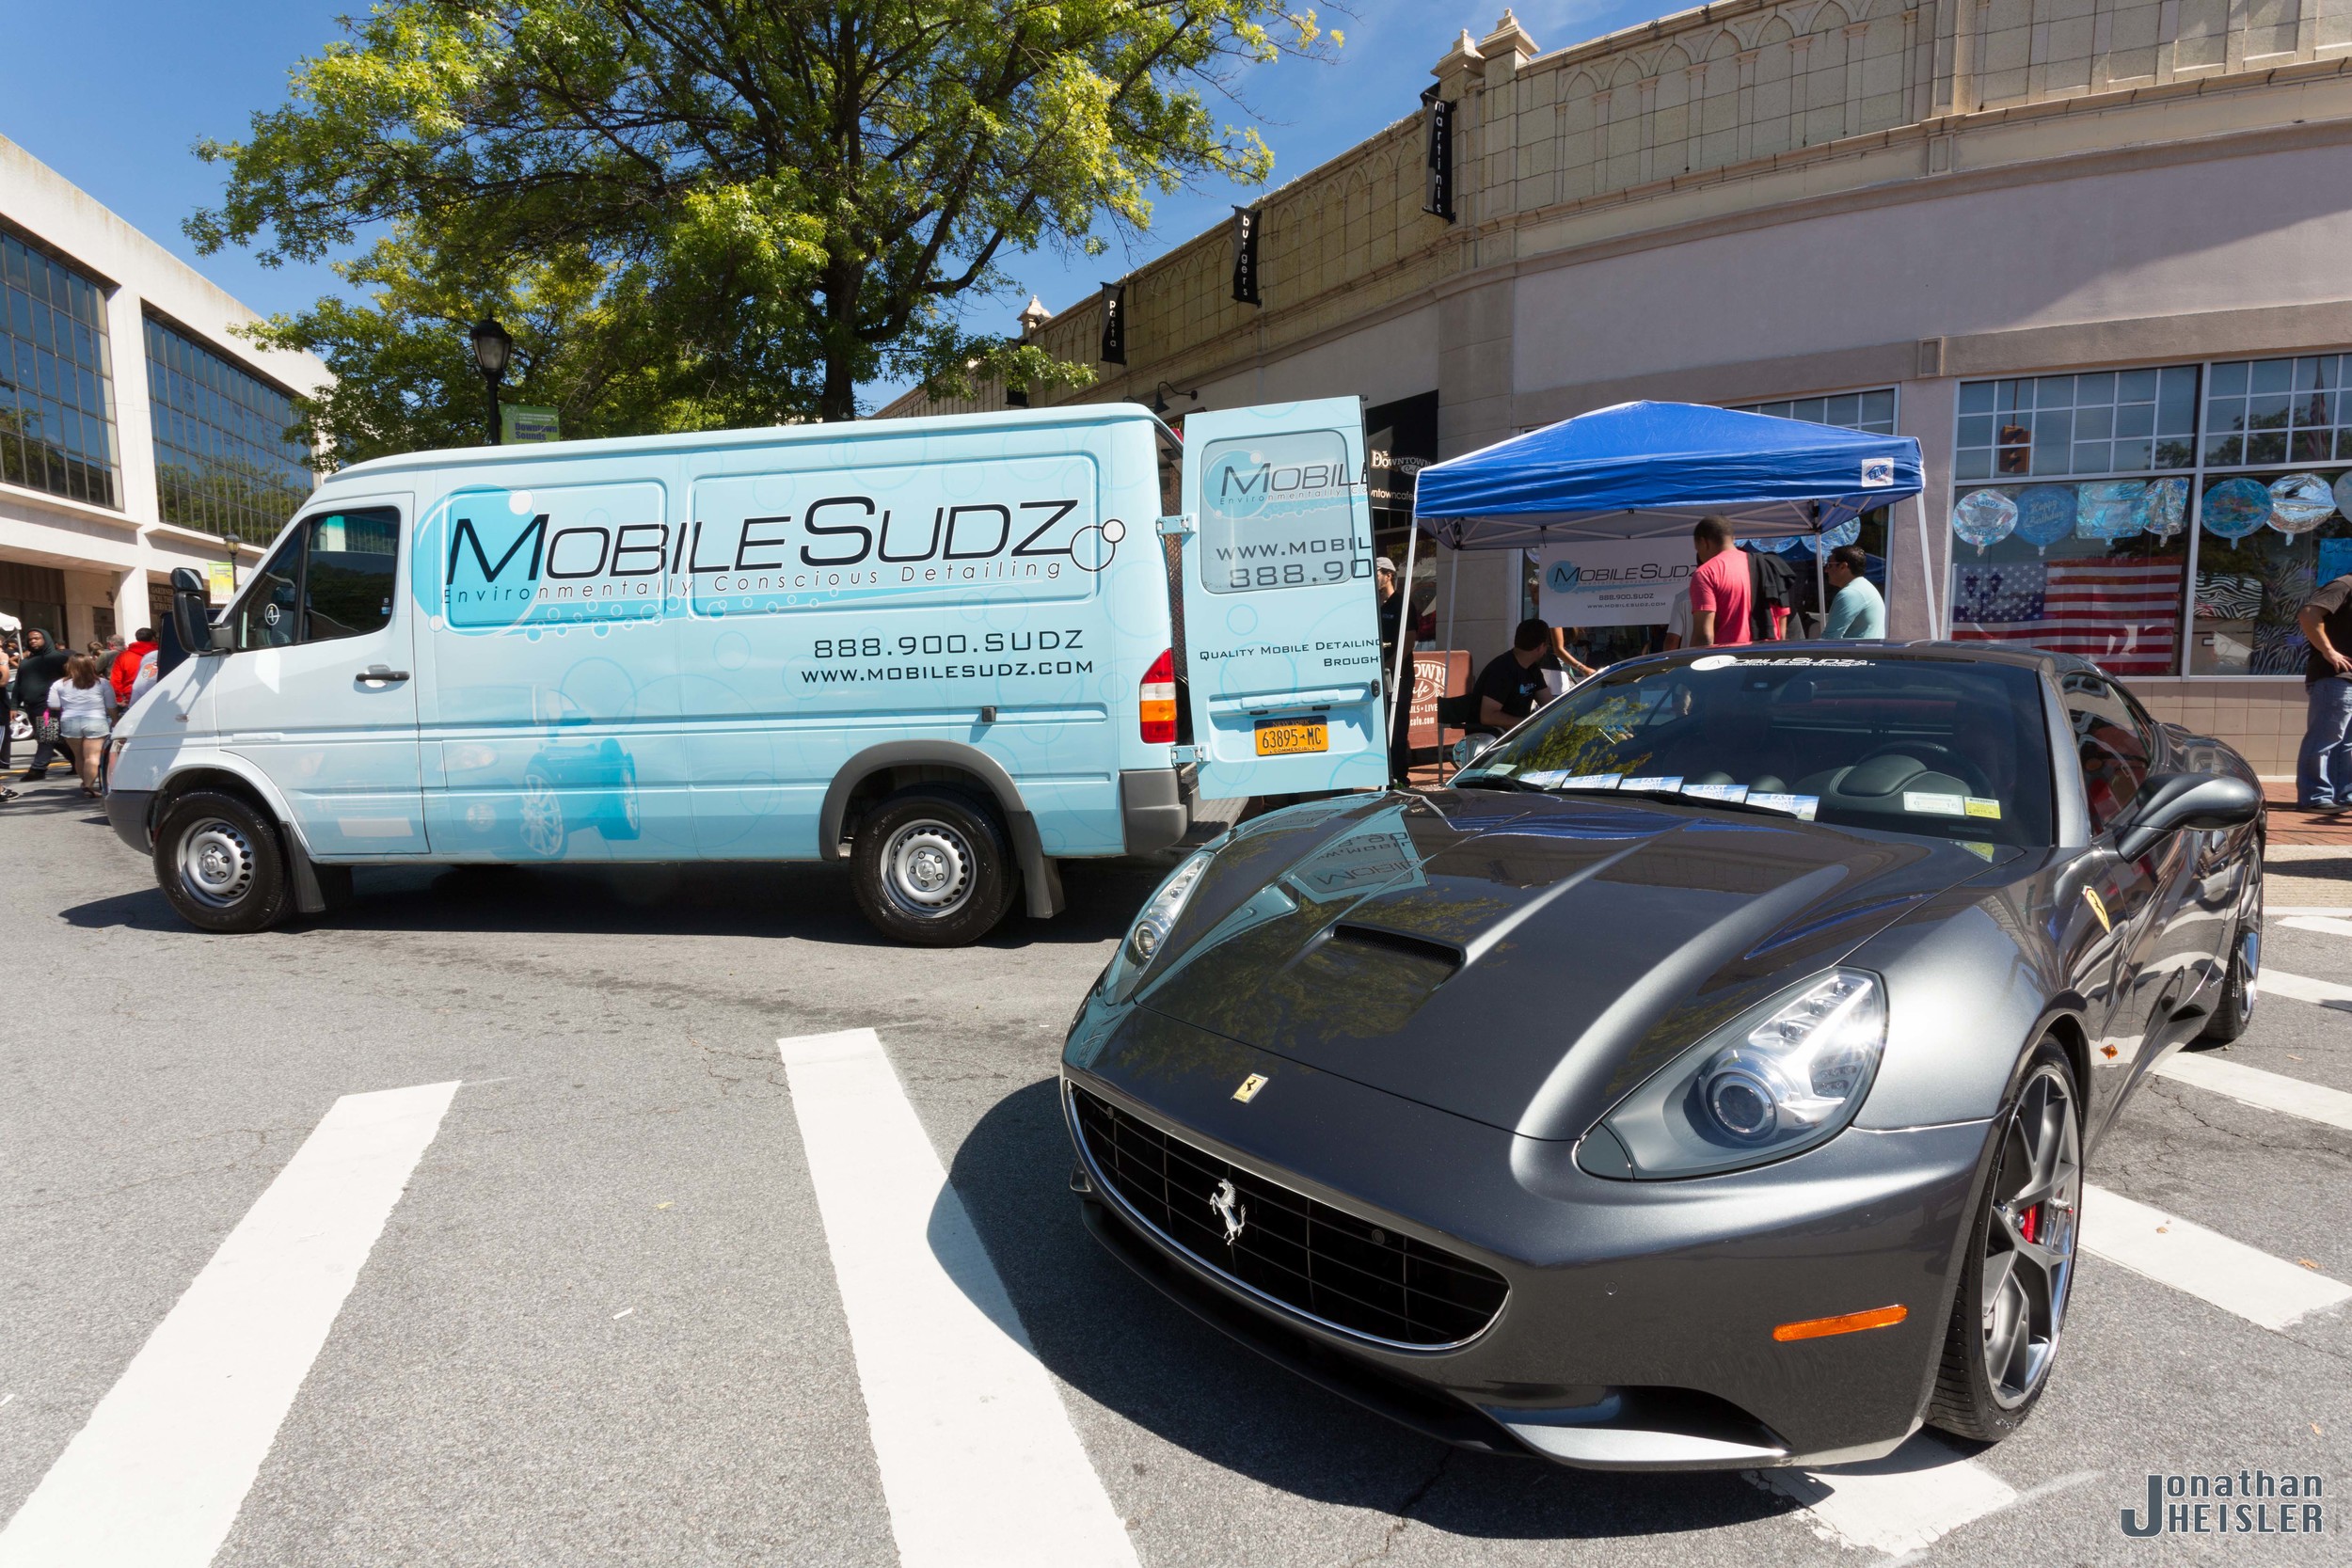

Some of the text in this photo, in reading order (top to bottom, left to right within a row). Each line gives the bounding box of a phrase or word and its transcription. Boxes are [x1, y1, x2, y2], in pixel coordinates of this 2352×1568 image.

[1435, 101, 1445, 214] martinis
[1241, 216, 1250, 296] burgers
[515, 422, 558, 433] Downtown
[515, 431, 547, 441] Sounds
[1219, 488, 1342, 505] Environmentally
[440, 560, 1061, 605] Environmentally Conscious Detailing
[1598, 593, 1655, 601] 888.900.SUDZ
[814, 629, 1084, 659] 888.900.SUDZ
[1200, 648, 1255, 661] QUALITY
[1261, 643, 1310, 656] MOBILE
[1324, 655, 1382, 667] BROUGH
[1272, 720, 1290, 728] NEW
